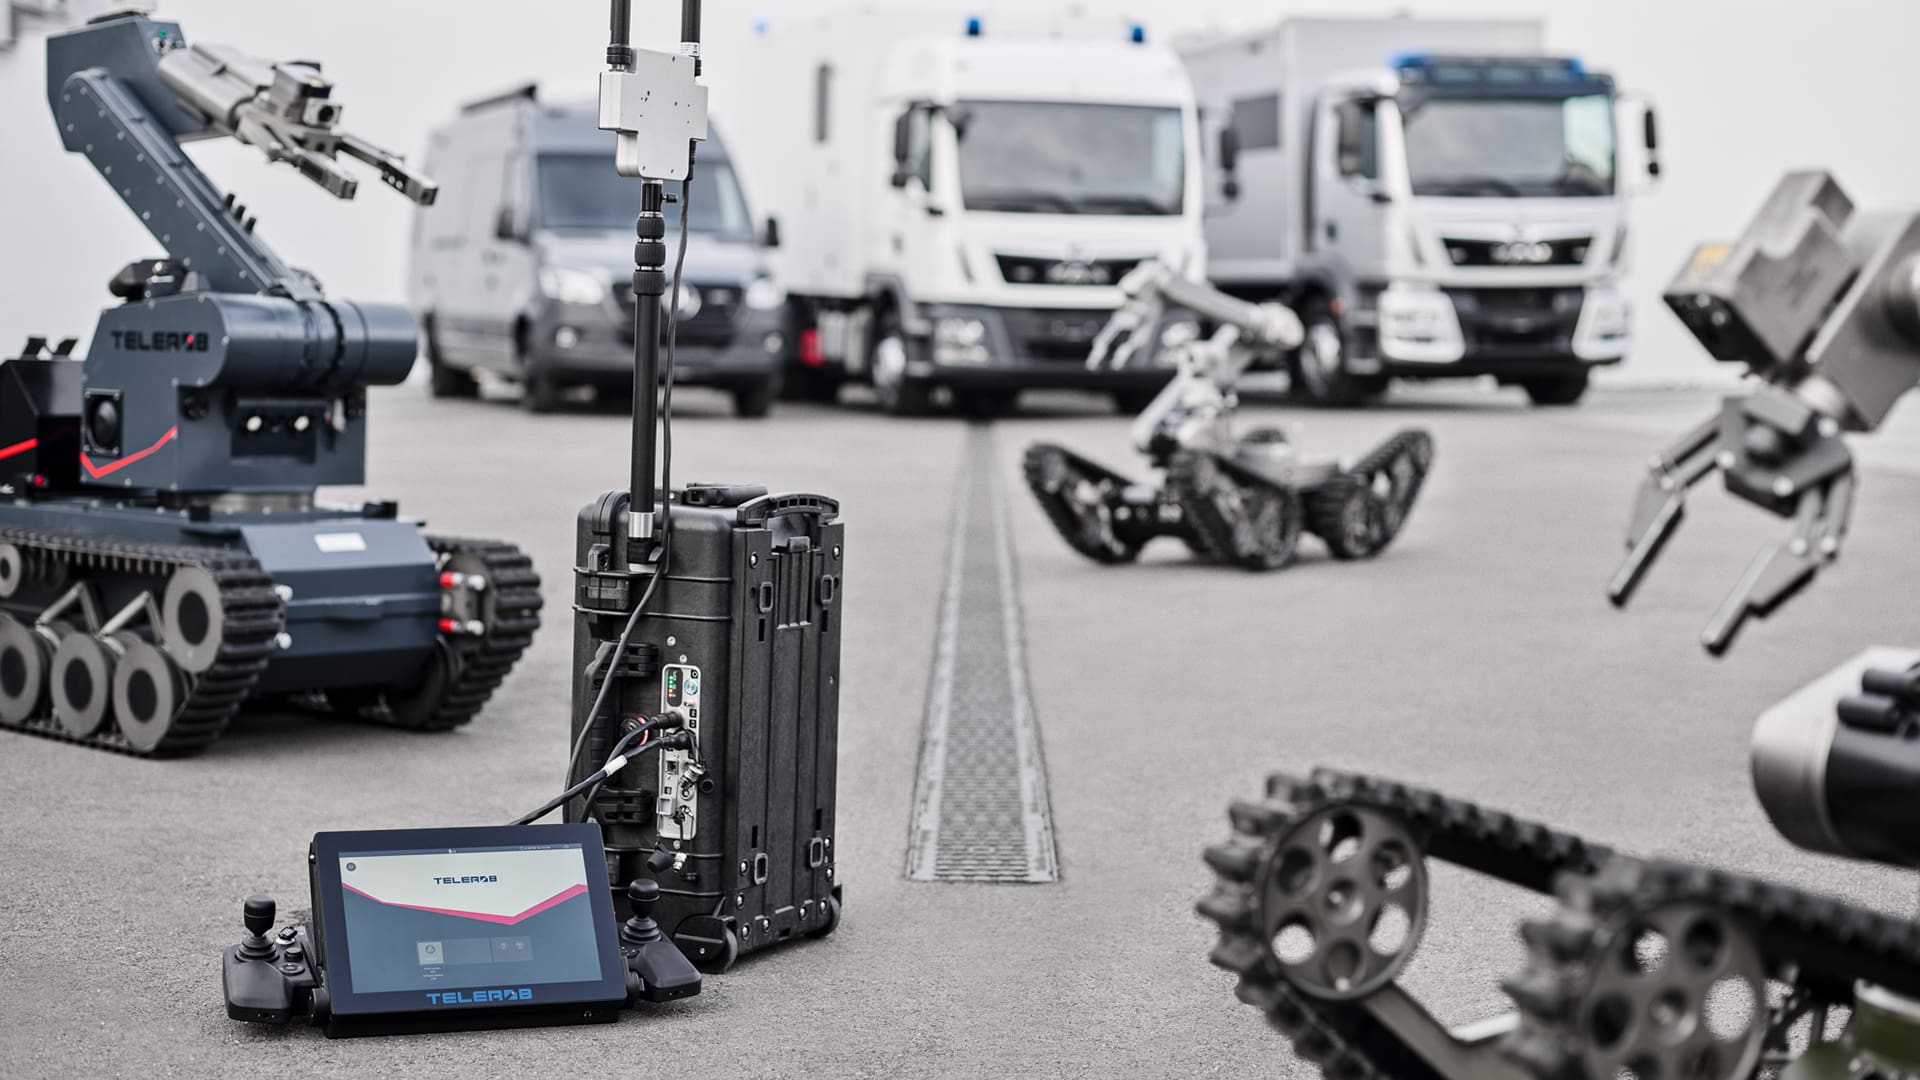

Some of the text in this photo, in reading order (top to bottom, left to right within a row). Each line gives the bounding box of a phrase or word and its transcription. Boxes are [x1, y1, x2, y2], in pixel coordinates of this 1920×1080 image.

[110, 330, 209, 352] TELEROB
[433, 875, 497, 885] TELEROB
[426, 988, 533, 1005] TELEROB
